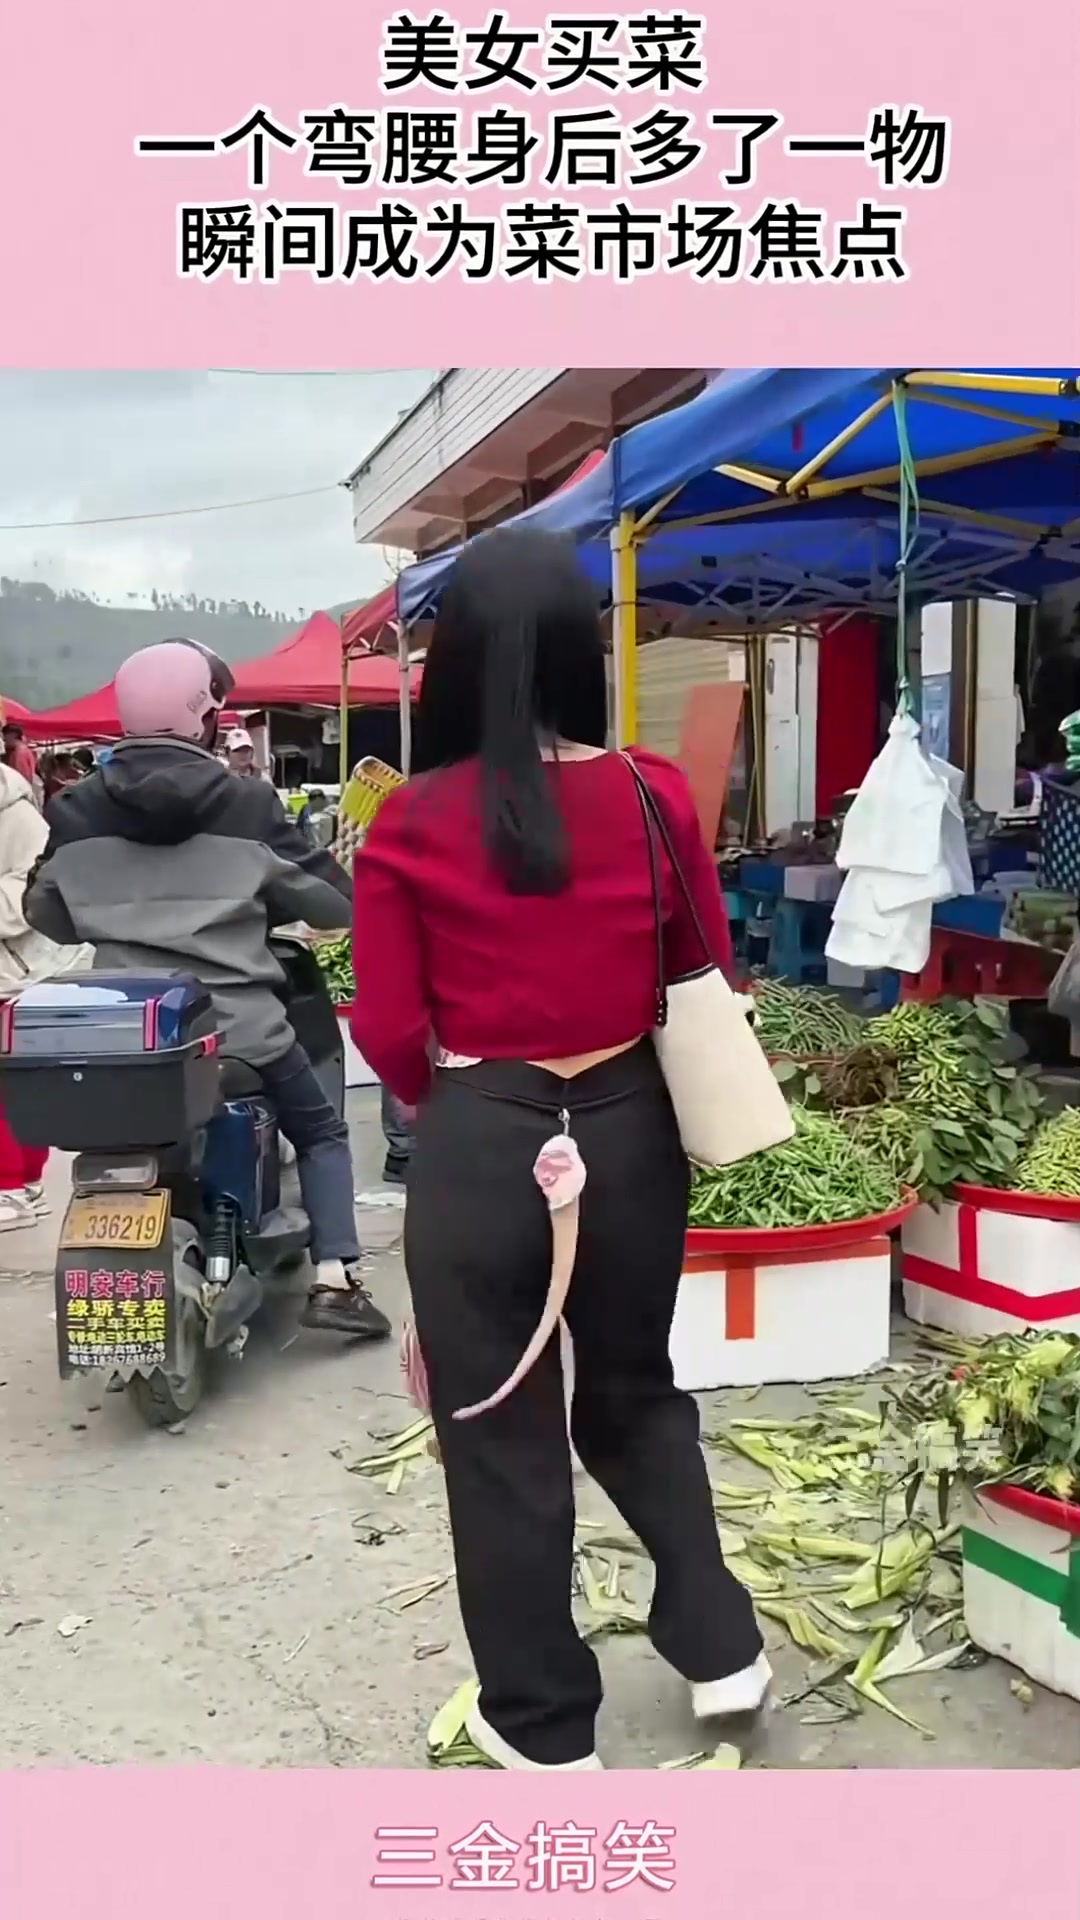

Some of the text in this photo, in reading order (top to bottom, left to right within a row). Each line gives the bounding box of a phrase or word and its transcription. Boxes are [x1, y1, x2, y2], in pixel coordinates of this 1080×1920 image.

[85, 1214, 156, 1241] 336219
[65, 1269, 166, 1298] 明安车行
[66, 1317, 165, 1331] 二手车买卖
